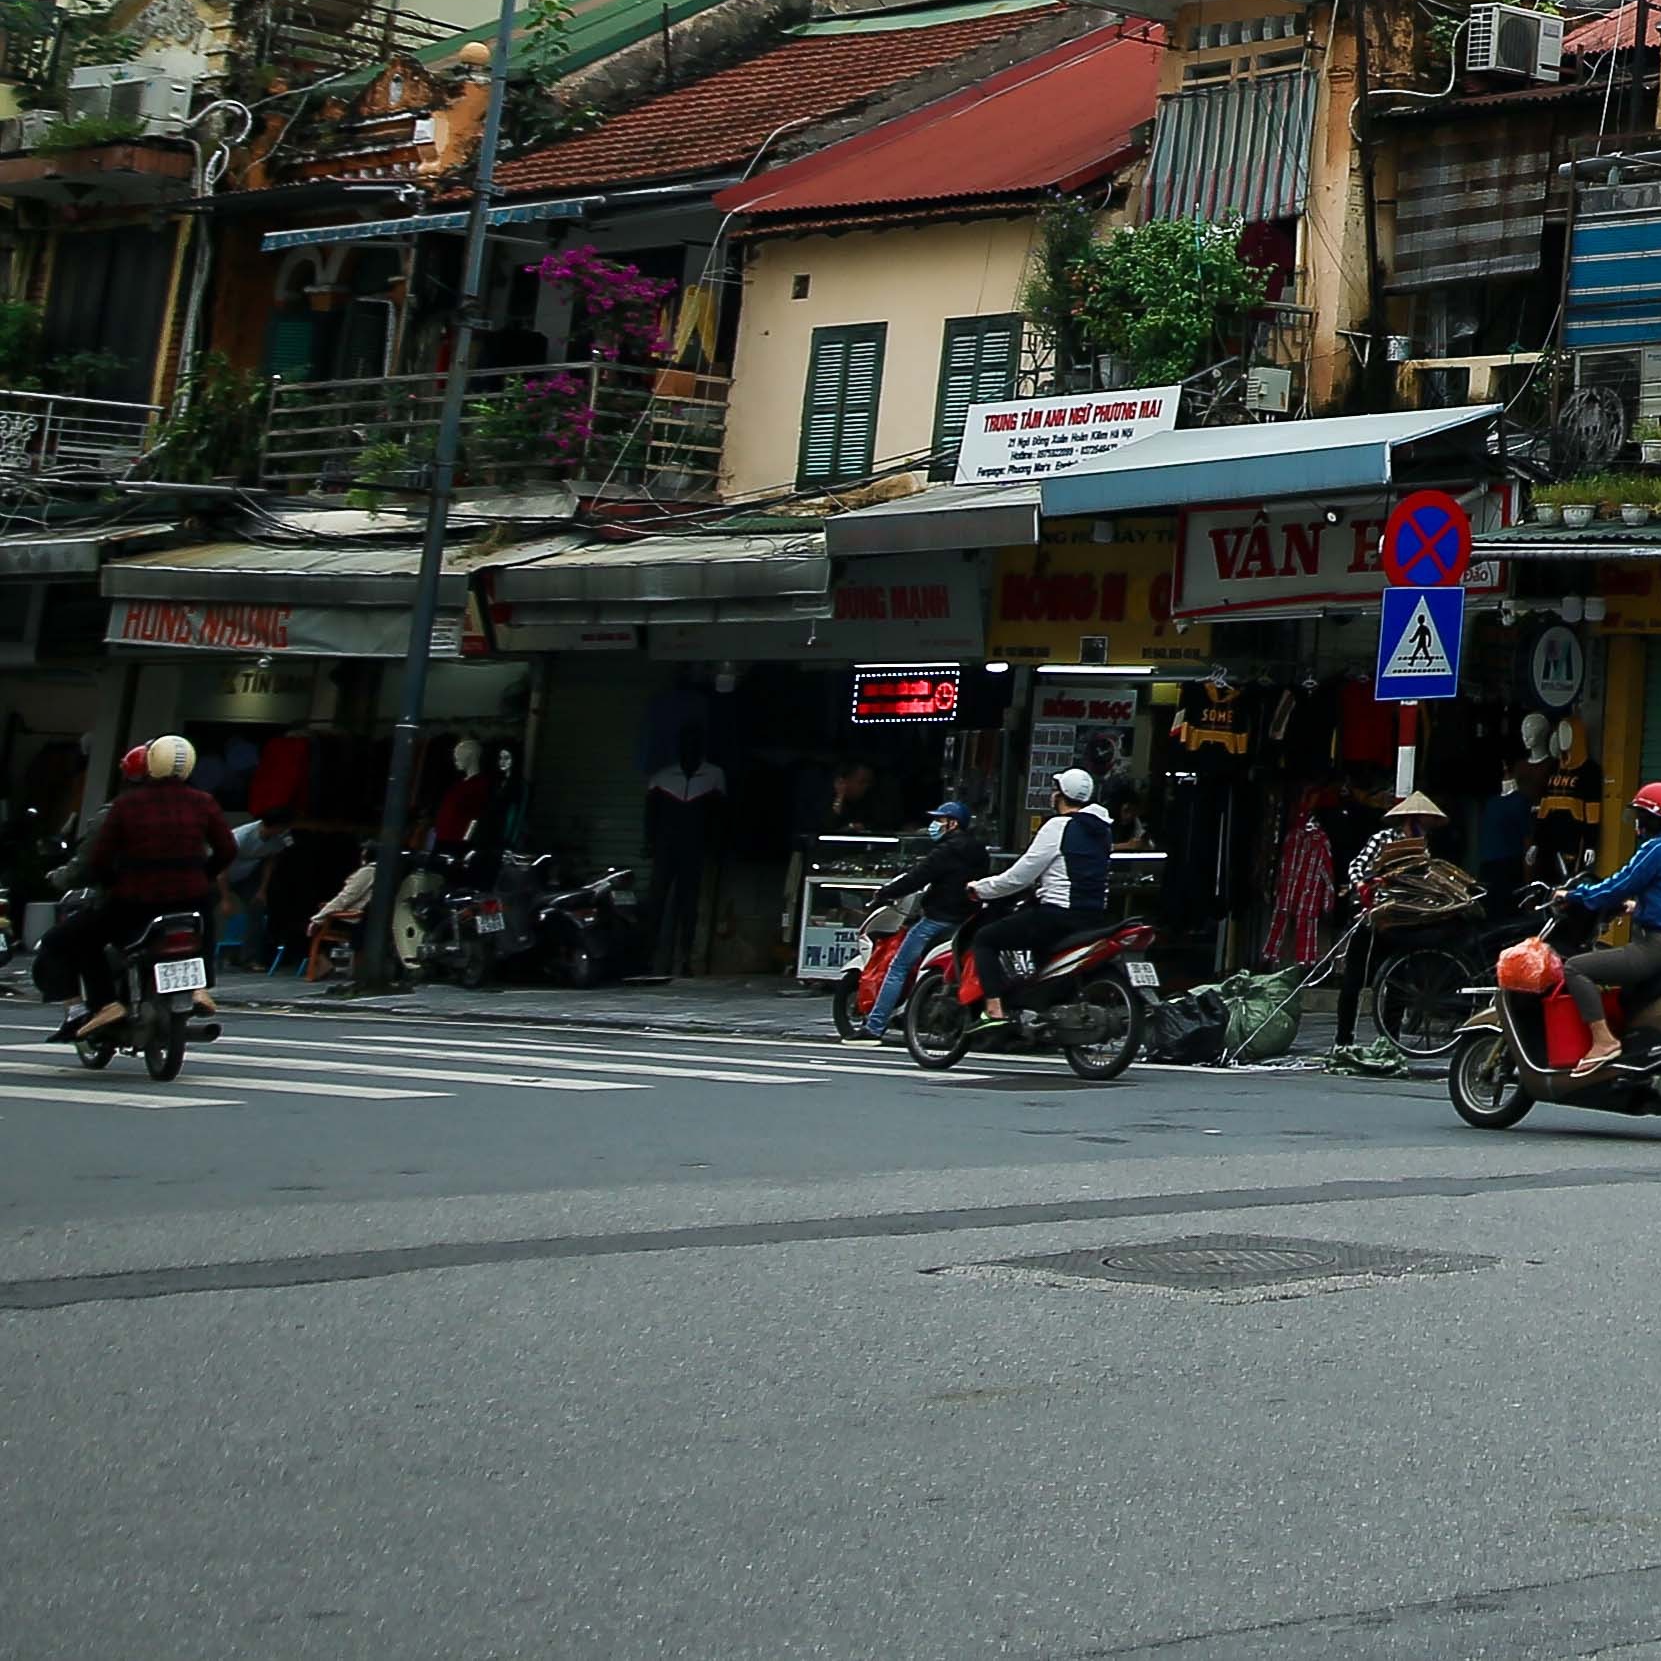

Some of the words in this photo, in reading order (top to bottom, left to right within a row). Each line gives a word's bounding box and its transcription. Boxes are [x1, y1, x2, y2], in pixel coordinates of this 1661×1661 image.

[984, 412, 1018, 433] TRUNG
[1044, 409, 1067, 427] ANH
[1139, 399, 1163, 419] MAI
[1209, 509, 1326, 580] VÂN
